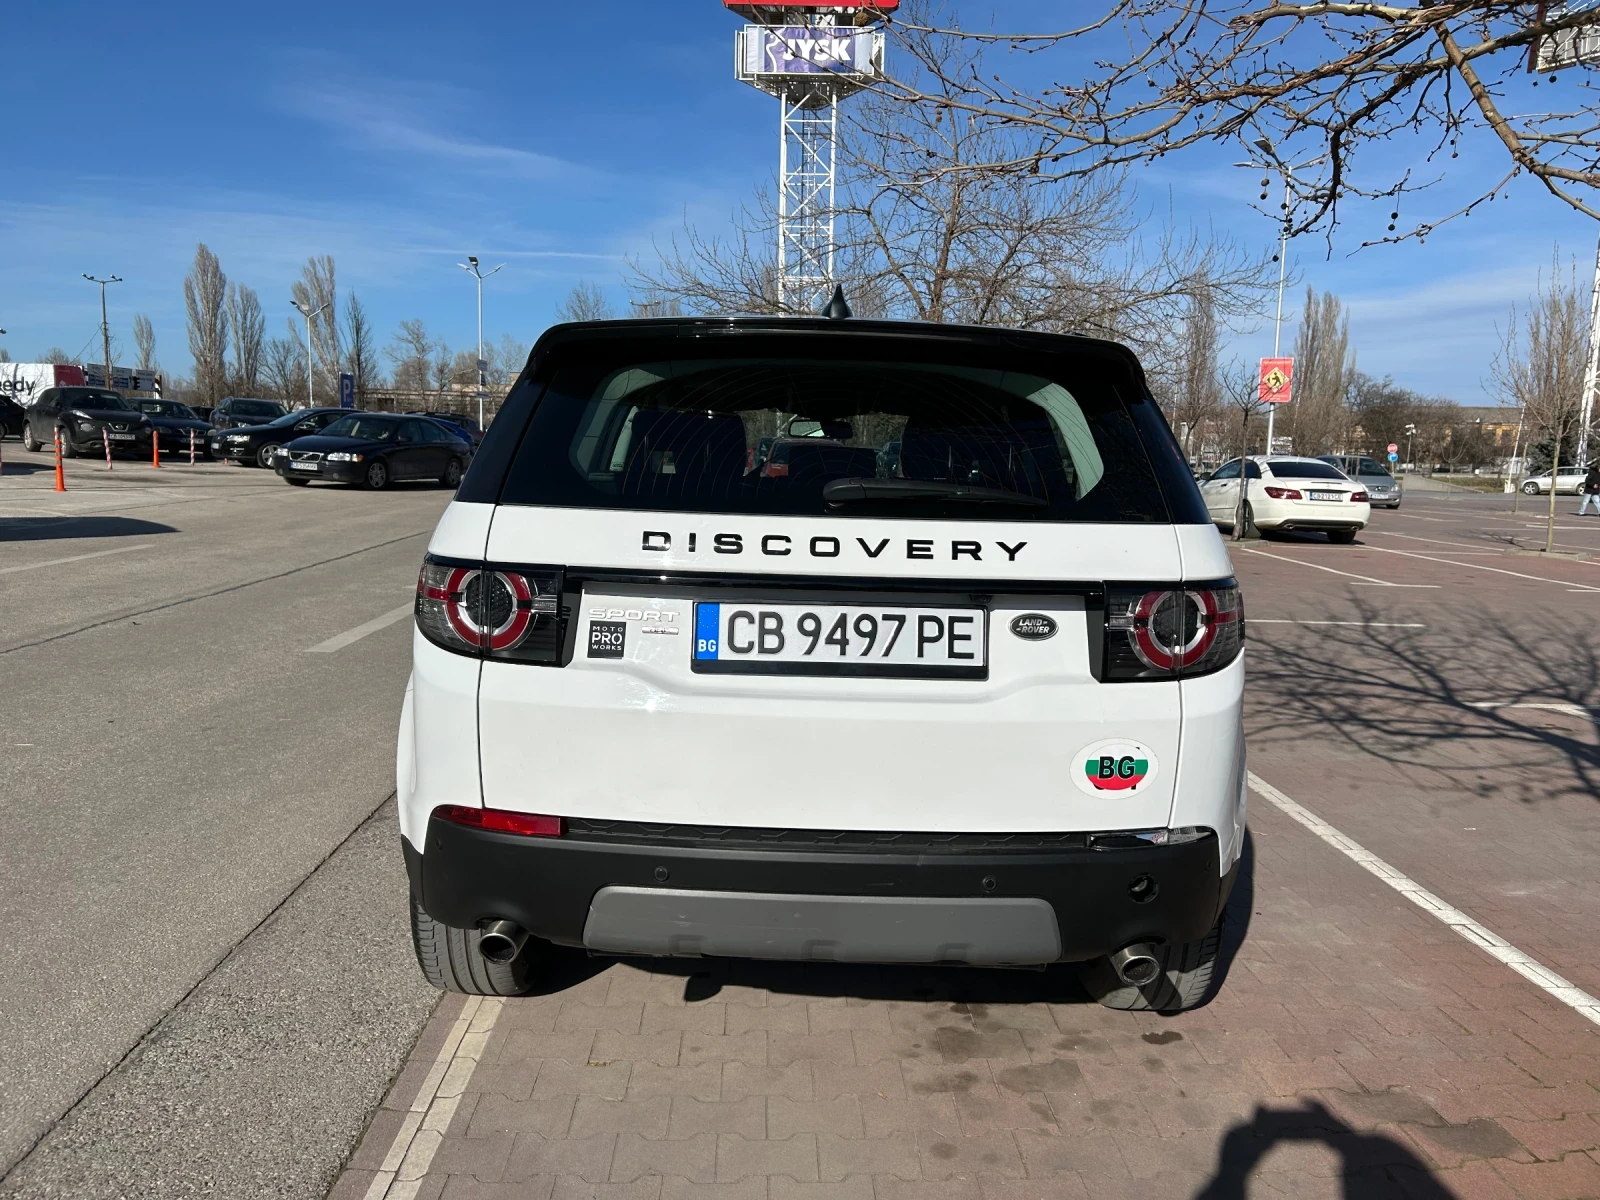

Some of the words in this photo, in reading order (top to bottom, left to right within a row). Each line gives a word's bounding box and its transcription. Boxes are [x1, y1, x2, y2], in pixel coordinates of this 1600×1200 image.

[782, 38, 851, 60] JYSK
[343, 378, 351, 402] P
[641, 531, 1028, 561] DISCOVERY
[588, 608, 680, 622] SPORT
[591, 632, 622, 645] PRO
[698, 639, 717, 653] BG
[727, 610, 785, 655] CB
[797, 612, 906, 657] 9497
[916, 614, 975, 660] PE
[1098, 755, 1135, 779] BG
